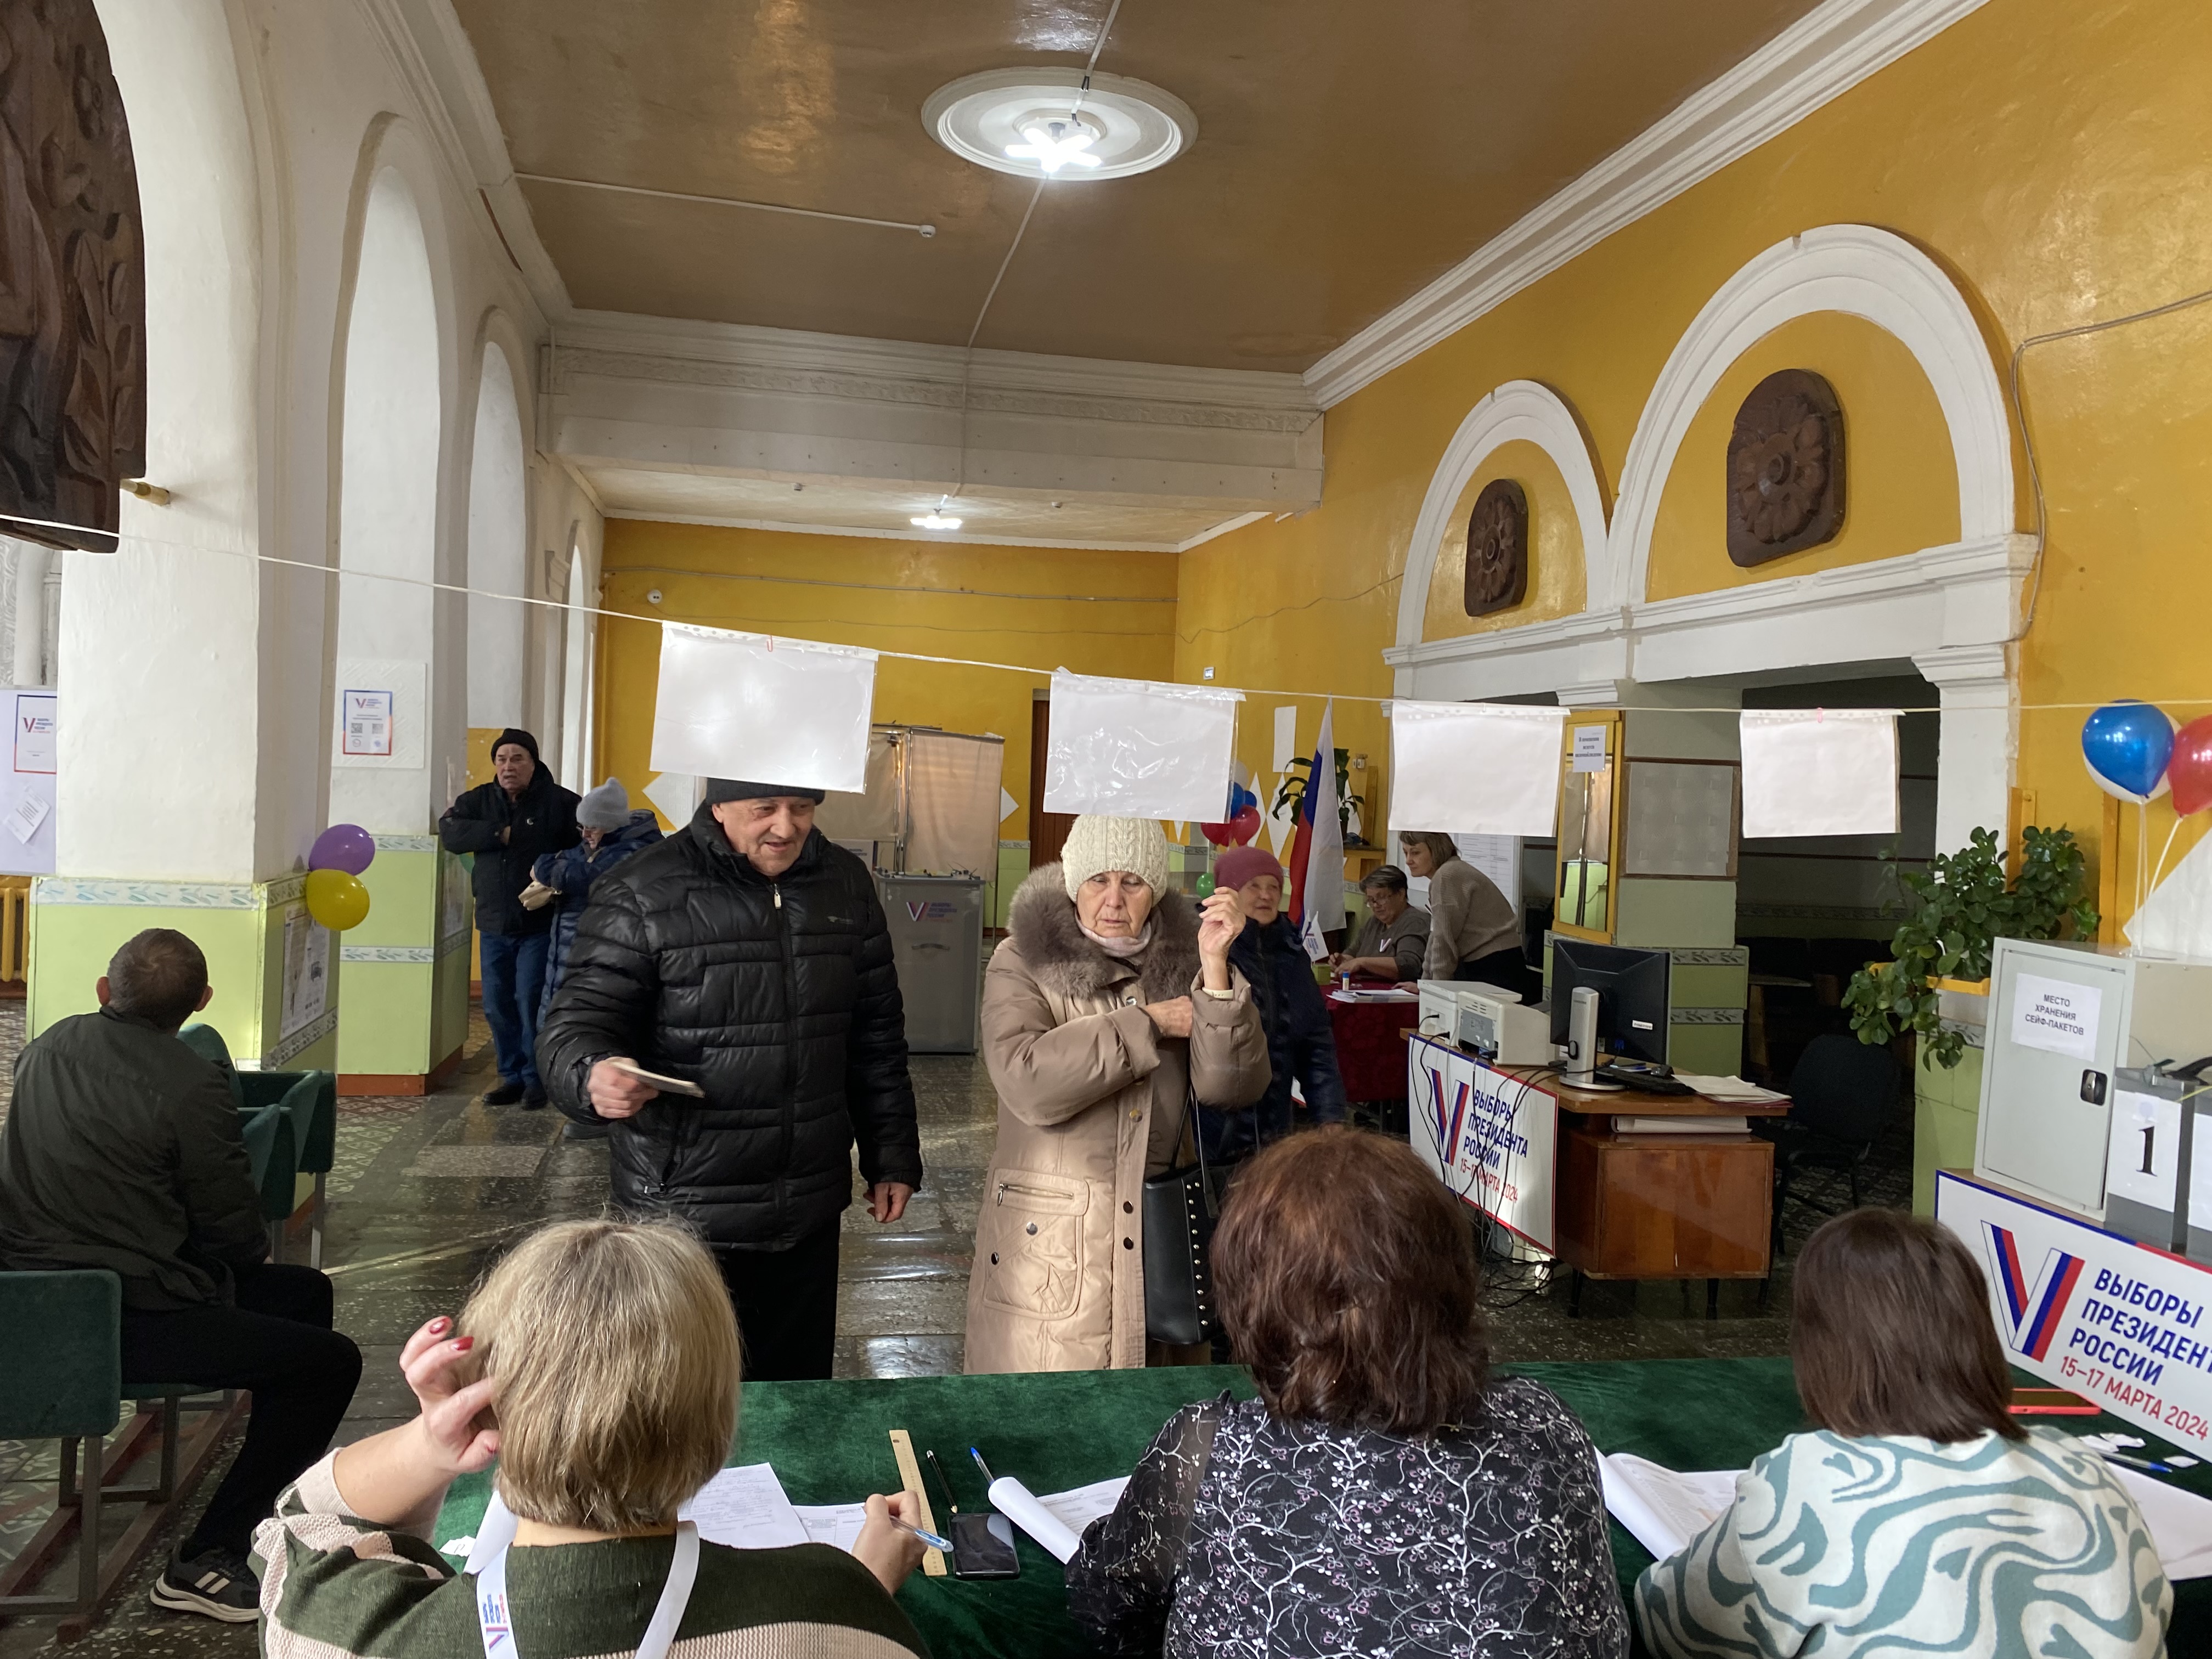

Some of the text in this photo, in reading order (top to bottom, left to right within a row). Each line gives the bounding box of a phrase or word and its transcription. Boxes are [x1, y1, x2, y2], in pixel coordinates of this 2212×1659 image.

[2025, 1013, 2084, 1036] СЕЙФ-ПАКЕТОВ
[2035, 1003, 2076, 1021] ХРАНЕНИЯ
[2044, 994, 2070, 1007] МЕСТО
[2136, 1126, 2158, 1177] 1
[2094, 1267, 2204, 1328] ВЫБОРЫ
[2069, 1327, 2164, 1386] РОССИИ
[2103, 1376, 2163, 1420] МАРТА
[2164, 1405, 2209, 1441] 2024
